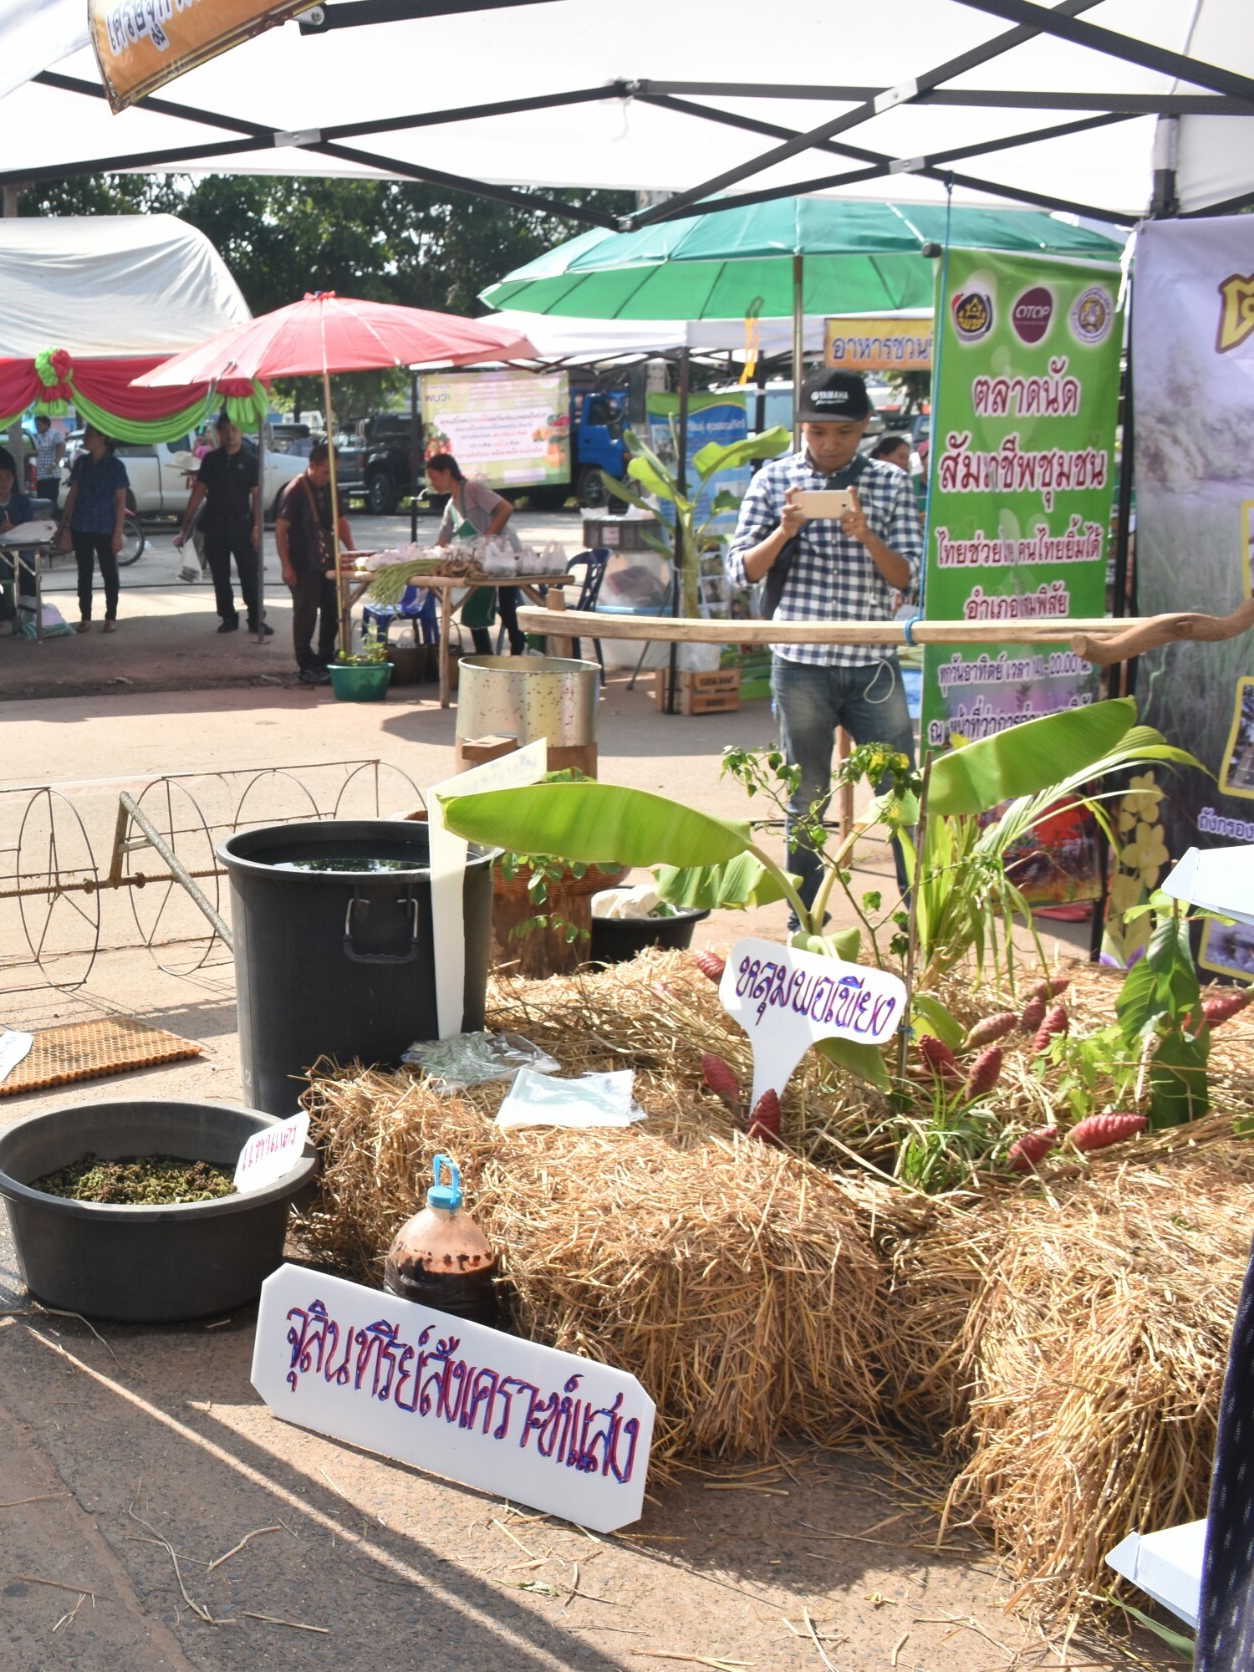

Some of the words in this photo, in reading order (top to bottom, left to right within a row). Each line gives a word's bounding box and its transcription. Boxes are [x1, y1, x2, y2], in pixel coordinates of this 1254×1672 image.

[1015, 304, 1050, 319] OTOP
[973, 359, 1079, 414] ตลาดนัด
[735, 955, 897, 1038] หลุมพอเพียง
